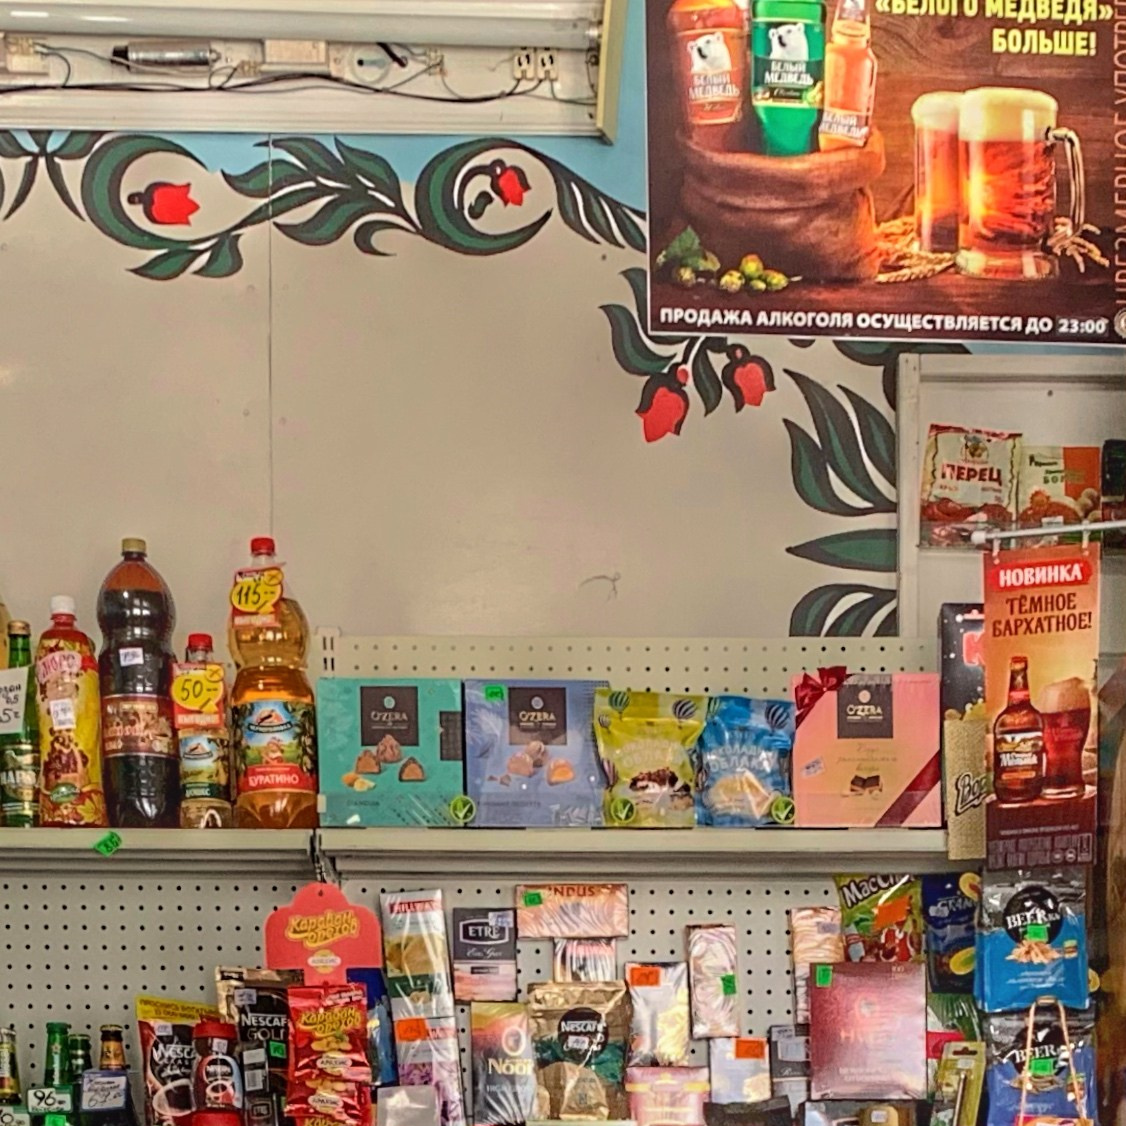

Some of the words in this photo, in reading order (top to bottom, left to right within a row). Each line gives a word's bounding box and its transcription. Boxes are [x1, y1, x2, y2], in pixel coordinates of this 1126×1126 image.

[992, 28, 1096, 57] БОЛЬШЕ!
[660, 307, 753, 327] ПРОДАЖА
[756, 309, 852, 330] АЛКОГОЛЯ
[856, 311, 1022, 334] ОСУЩЕСТВЛЯЕТСЯ
[1025, 316, 1053, 335] ДО
[1057, 317, 1107, 334] 23:00
[940, 463, 1003, 486] ПЕРЕЦ
[999, 562, 1083, 588] НОВИНКА
[1005, 592, 1078, 616] ТЁМНОЕ
[992, 611, 1093, 638] БАРХАТНОЕ!
[241, 1012, 288, 1027] NESCAF
[152, 1044, 198, 1061] NESCA
